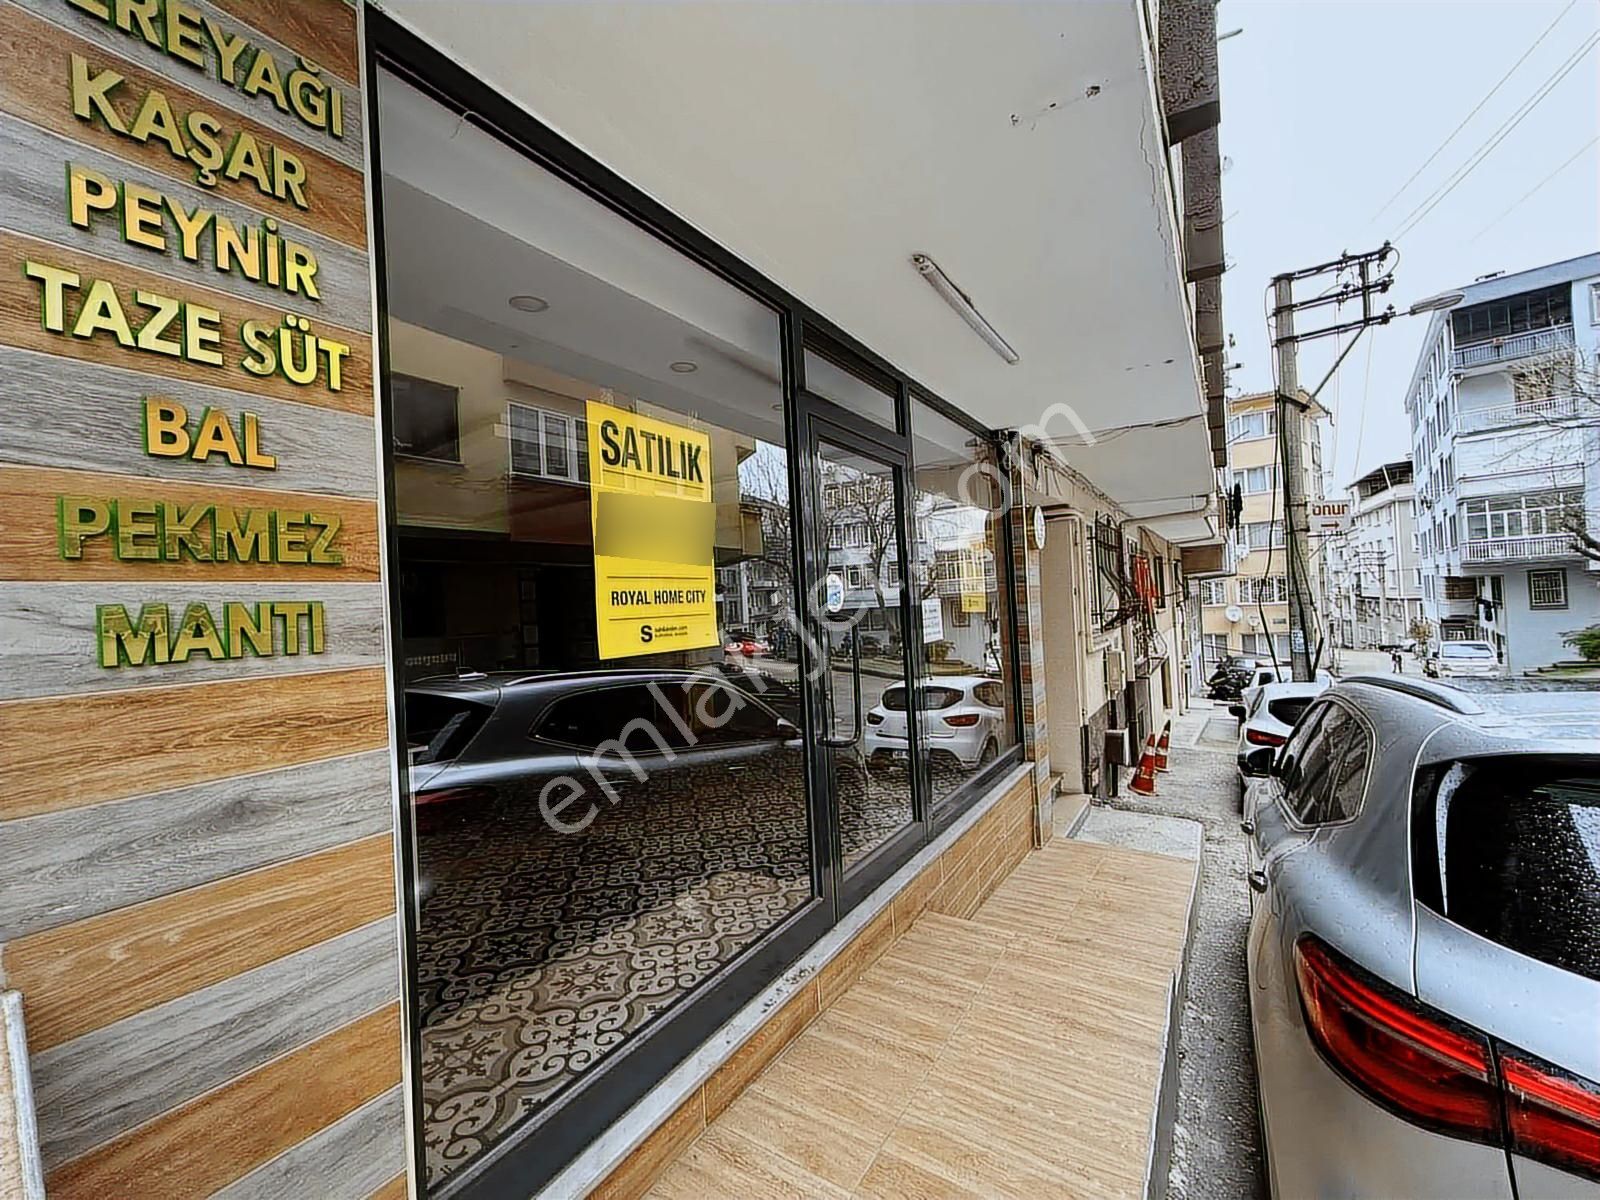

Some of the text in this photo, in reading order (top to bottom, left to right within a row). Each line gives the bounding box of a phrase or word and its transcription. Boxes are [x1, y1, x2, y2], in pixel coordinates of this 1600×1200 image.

[69, 52, 309, 209] KAŞAR
[65, 160, 321, 301] PEYNİR
[24, 260, 350, 391] TAZE SÜT
[142, 396, 278, 470] BAL
[600, 419, 704, 483] SATILIK
[57, 496, 343, 565] PEKMEZ
[611, 589, 706, 606] ROYAL HOME CITY
[95, 601, 325, 668] MANTI
[640, 624, 653, 643] S
